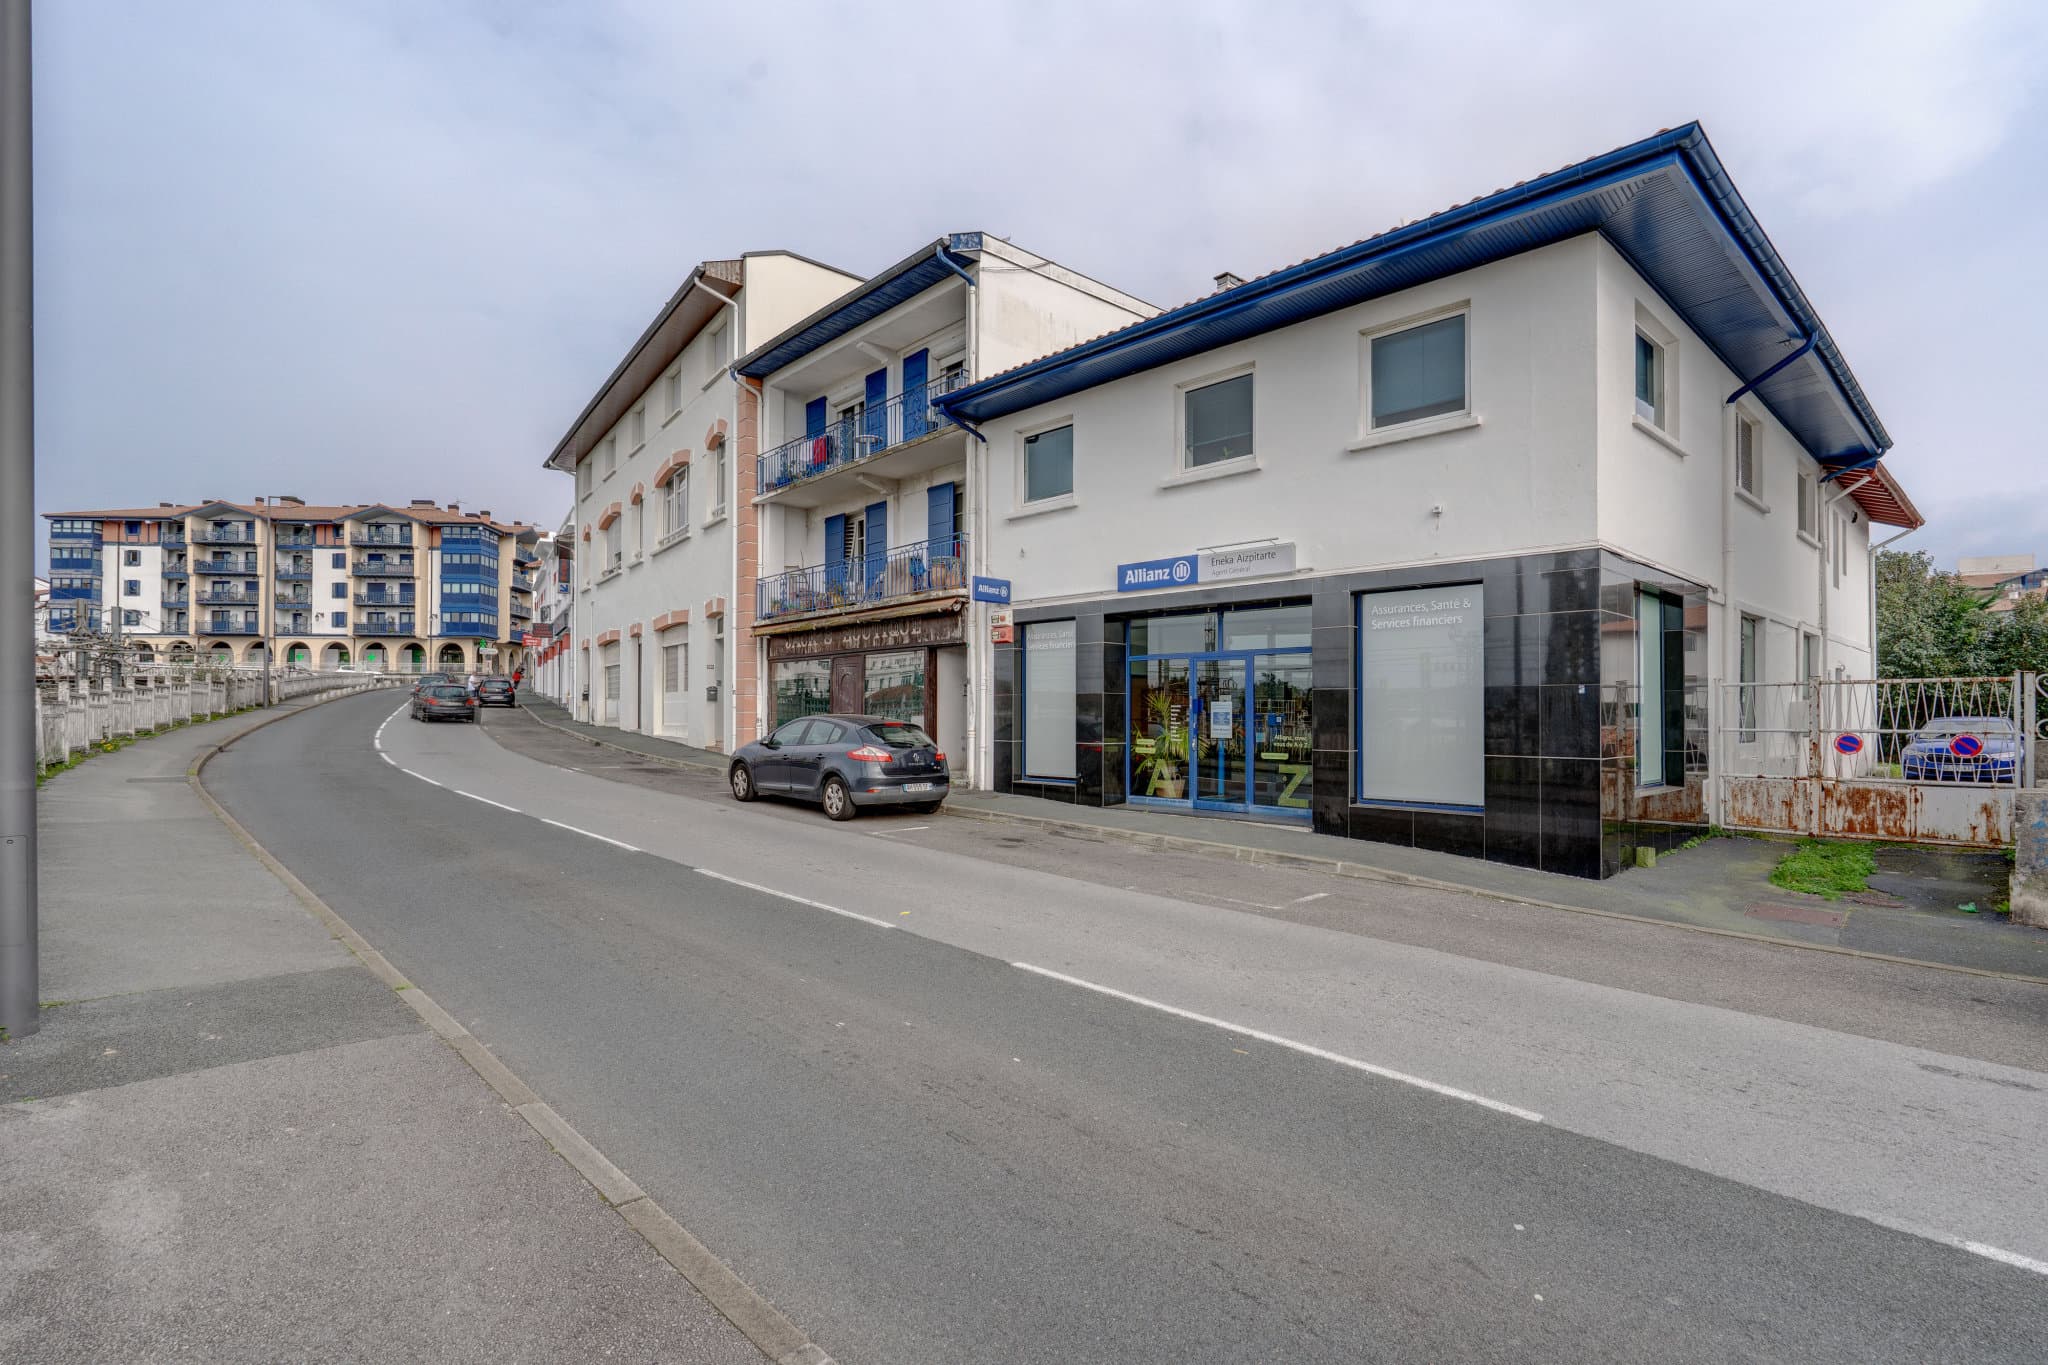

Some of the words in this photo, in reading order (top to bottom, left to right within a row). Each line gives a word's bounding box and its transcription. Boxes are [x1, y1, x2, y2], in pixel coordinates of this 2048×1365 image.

[1211, 556, 1234, 567] Eneka
[1237, 551, 1277, 563] Aizpitarte
[1125, 568, 1171, 585] Allianz
[978, 584, 1000, 595] Allianz
[1371, 602, 1429, 616] Assurances,
[1431, 600, 1459, 611] Santé
[1463, 598, 1472, 608] &
[1371, 616, 1410, 630] Services
[1413, 613, 1463, 627] financiers
[1146, 758, 1176, 798] A
[1278, 764, 1310, 808] Z
